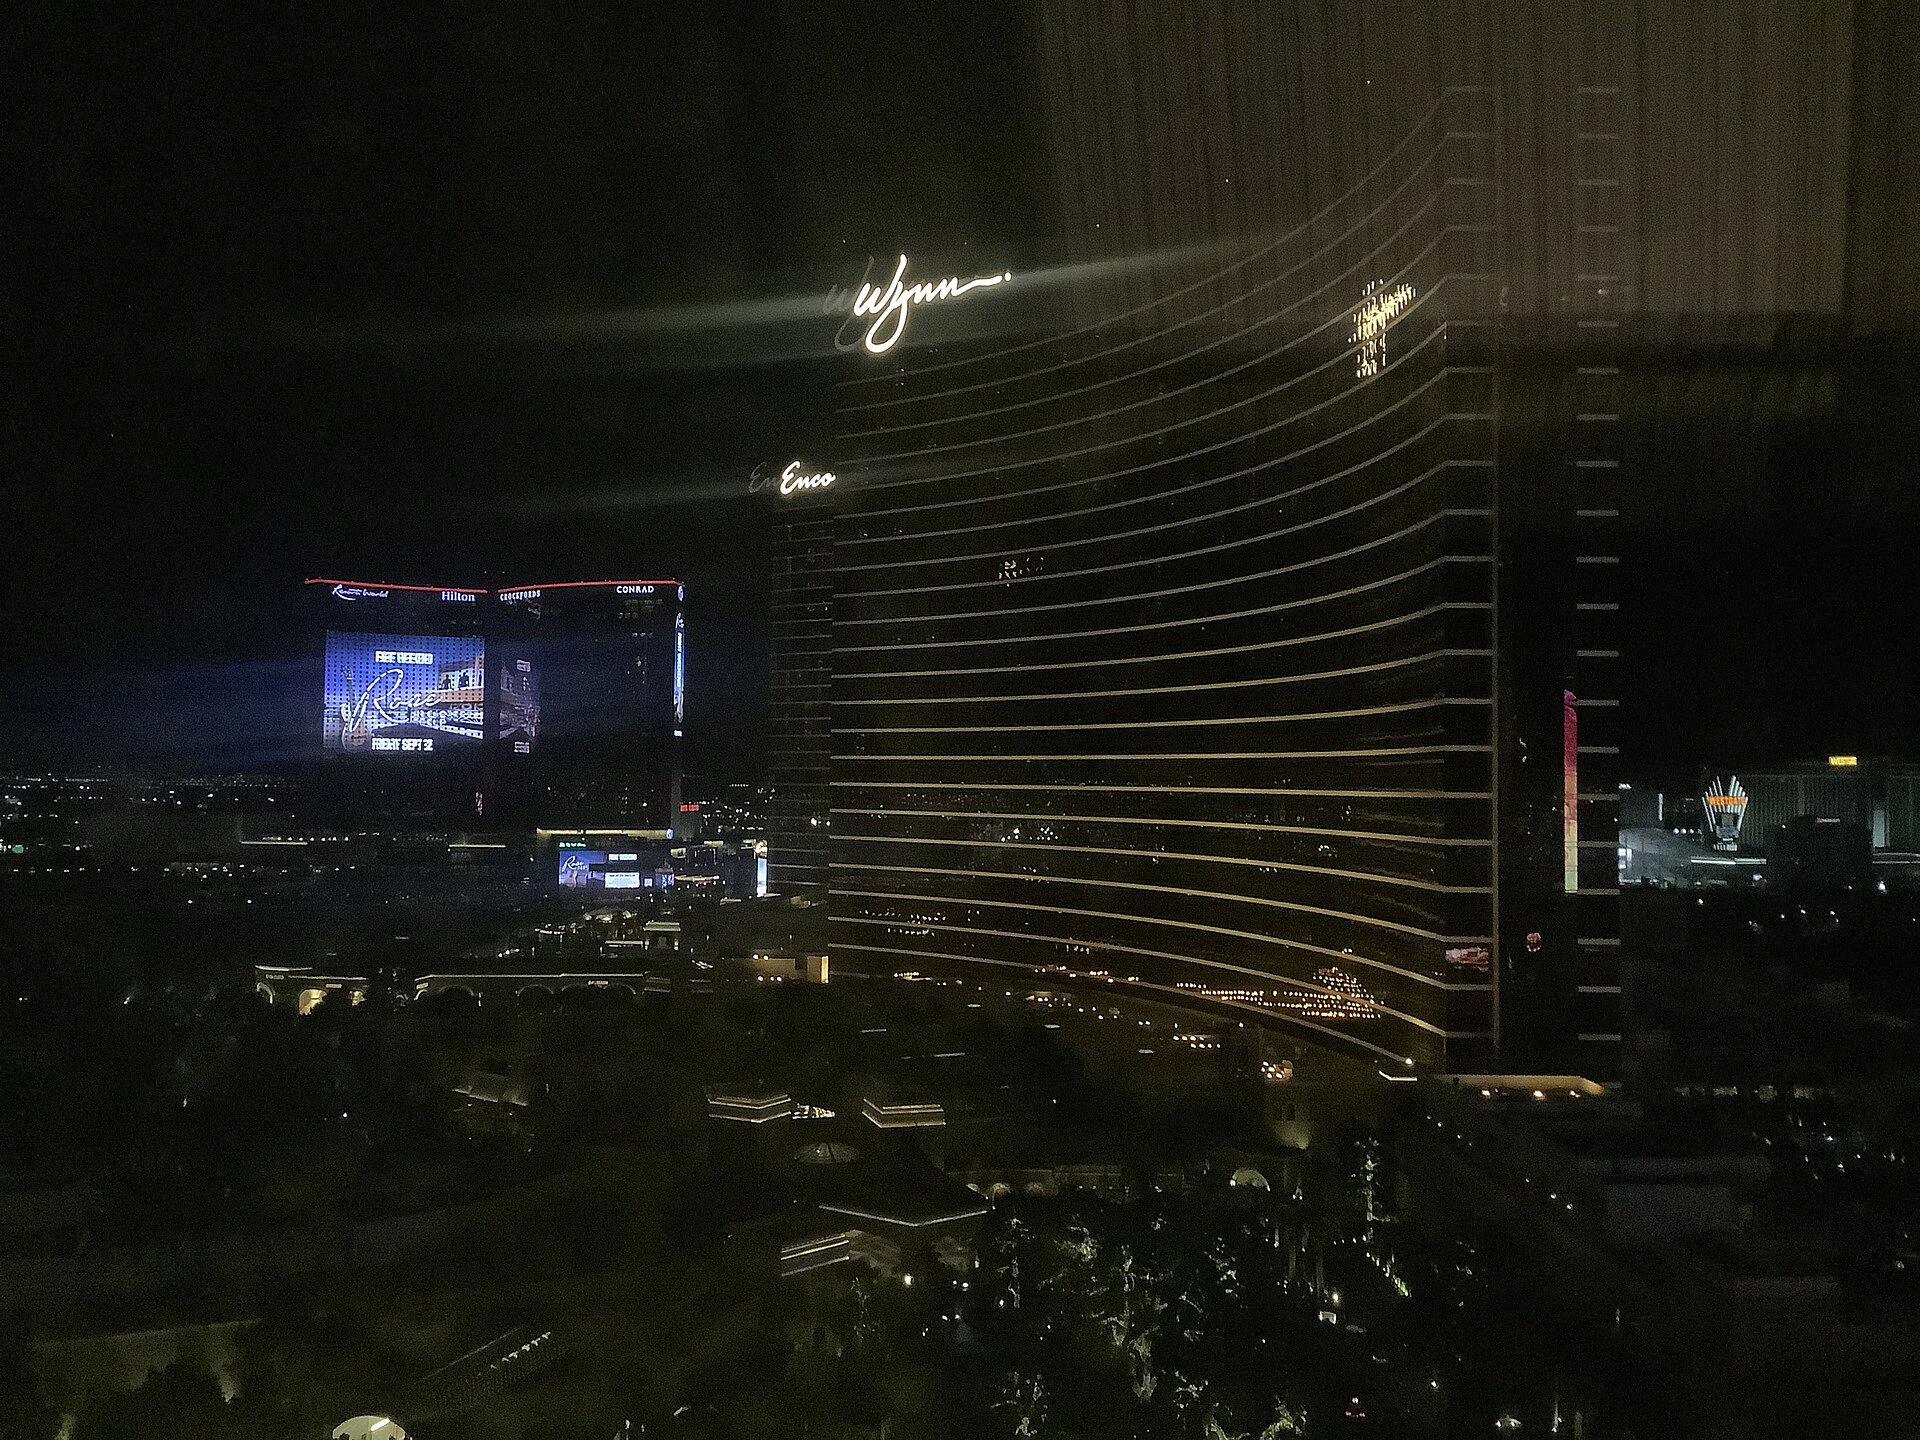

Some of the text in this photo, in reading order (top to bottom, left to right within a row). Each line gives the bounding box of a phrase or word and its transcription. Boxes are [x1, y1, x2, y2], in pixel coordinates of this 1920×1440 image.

[616, 586, 655, 594] CONRAD
[441, 591, 476, 602] Hilton
[499, 590, 541, 602] CROCKFORDS
